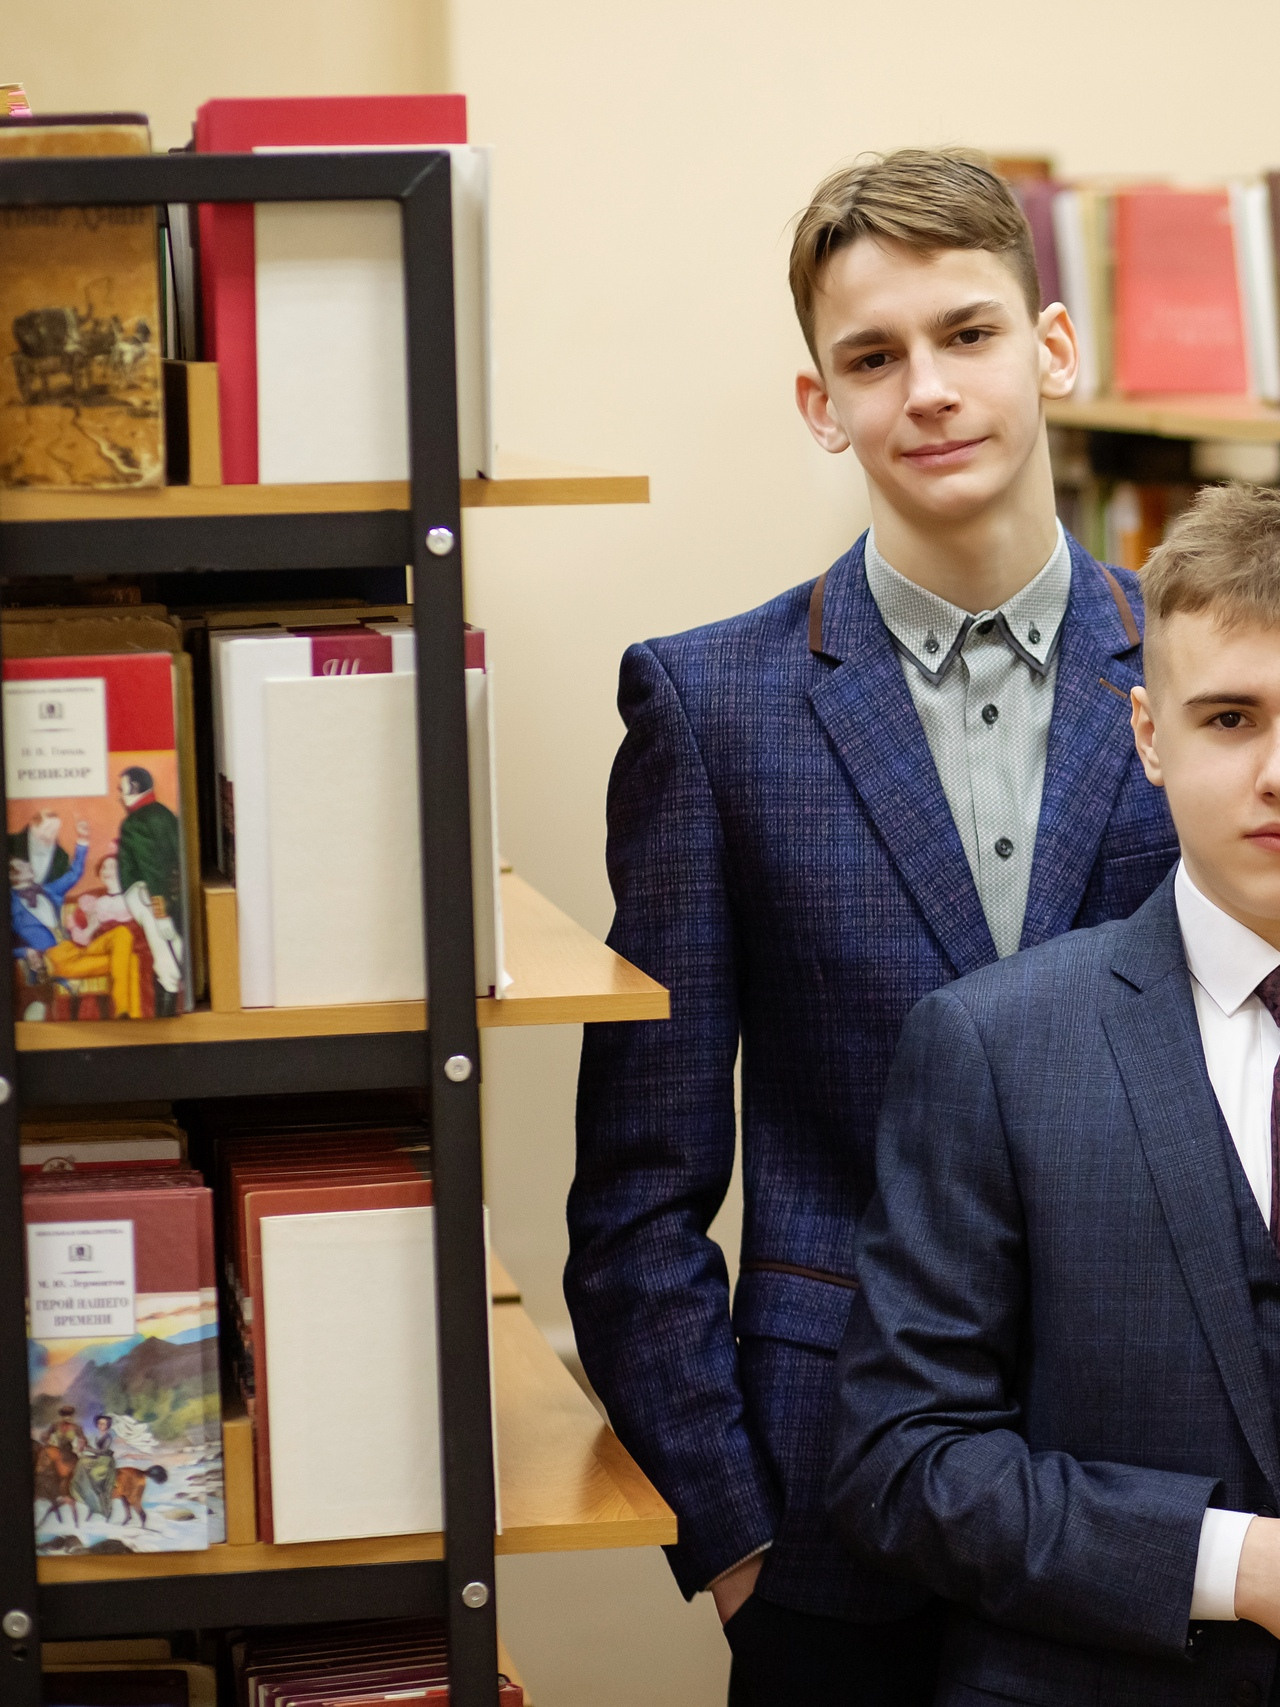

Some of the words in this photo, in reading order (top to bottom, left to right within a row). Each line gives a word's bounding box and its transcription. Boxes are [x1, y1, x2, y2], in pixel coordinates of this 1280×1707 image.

[17, 767, 91, 780] РЕВИЗОР
[35, 1297, 74, 1311] ГЕРОЙ
[77, 1297, 129, 1310] НАШЕГО
[54, 1314, 111, 1327] ВРЕМЕНИ
